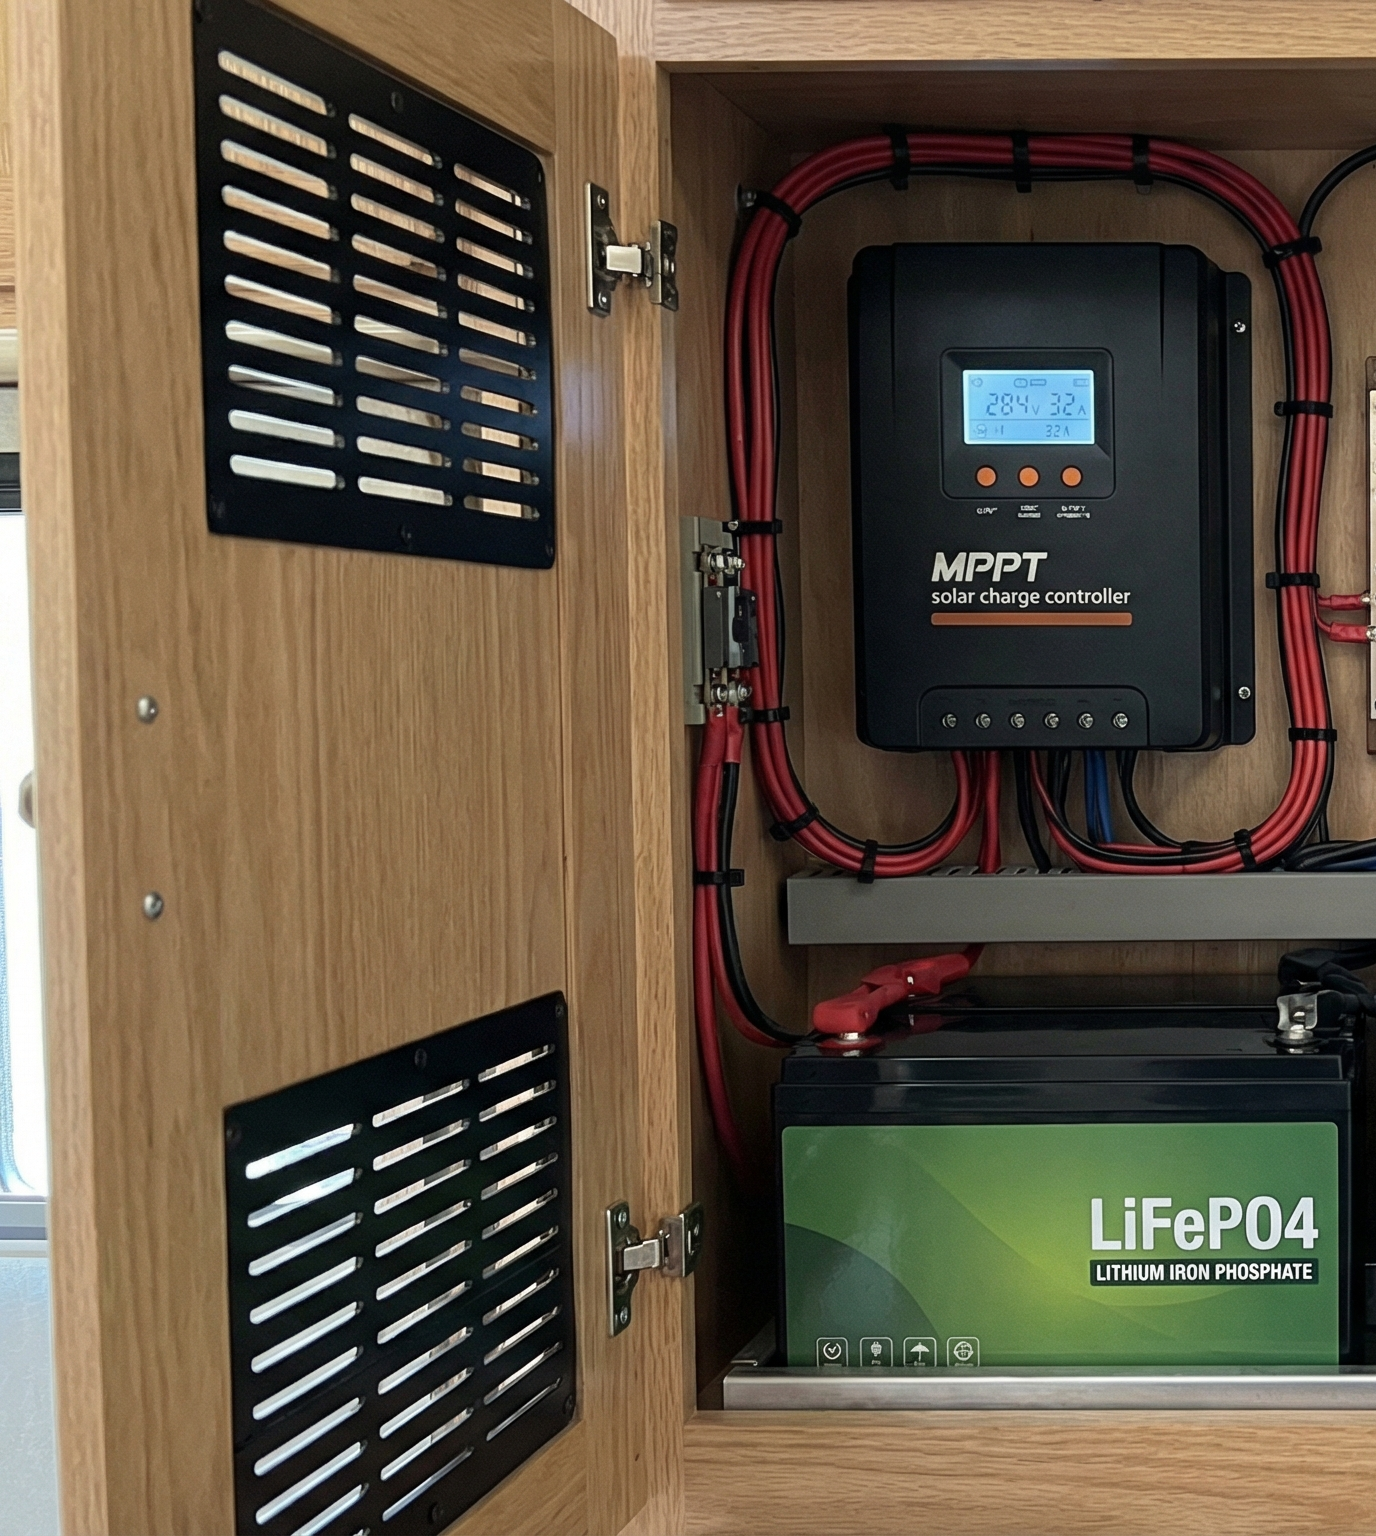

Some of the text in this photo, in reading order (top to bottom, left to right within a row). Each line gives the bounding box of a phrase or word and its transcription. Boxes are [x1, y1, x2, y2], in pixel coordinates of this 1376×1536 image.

[931, 552, 1048, 582] MPPT
[931, 587, 1131, 608] solar charge controller
[1091, 1195, 1319, 1251] LiFePO4
[1096, 1263, 1313, 1281] LITHIUM IRON PHOSPHATE
